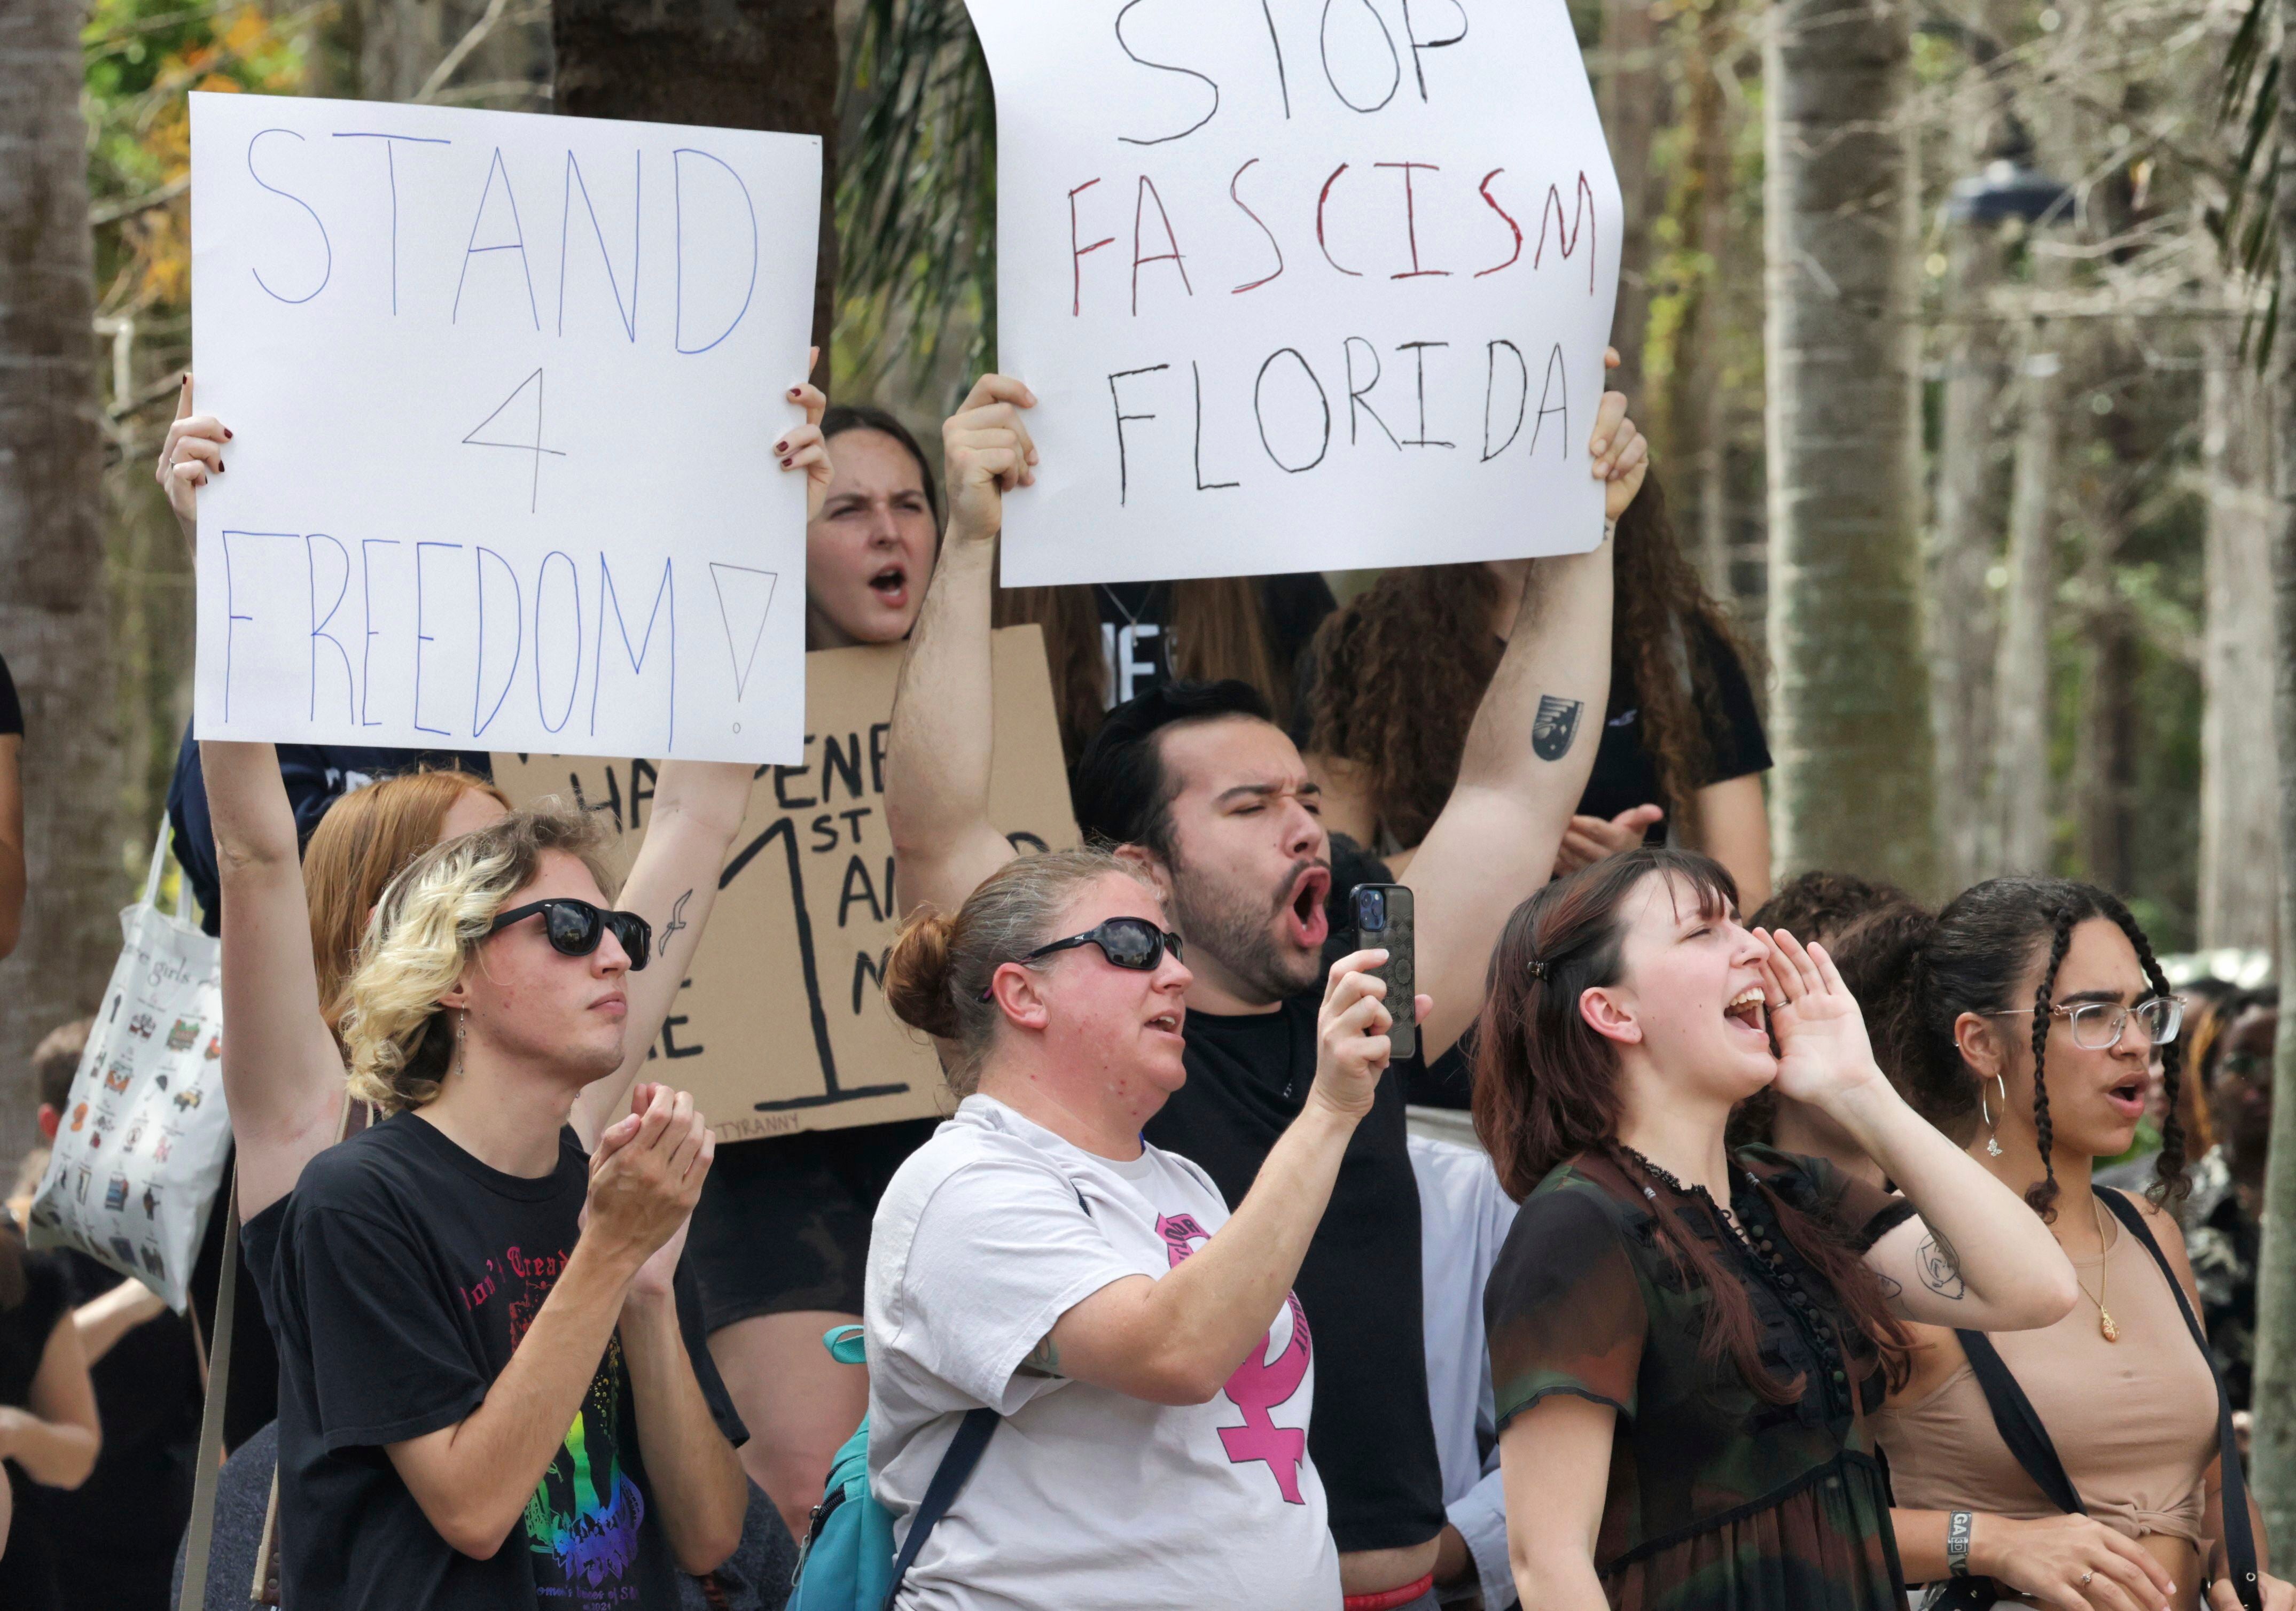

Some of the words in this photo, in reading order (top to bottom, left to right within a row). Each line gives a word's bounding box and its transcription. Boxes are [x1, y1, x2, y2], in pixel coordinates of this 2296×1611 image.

[1116, 0, 1468, 145] STOP
[248, 128, 757, 354] STAND
[1068, 158, 1596, 317] FASCISM
[462, 367, 566, 513] 4
[1108, 337, 1568, 508] FLORIDA
[222, 530, 778, 753] FREEDOM!
[714, 1112, 799, 1139] TYRANNY
[1288, 1291, 1308, 1357] UALITY
